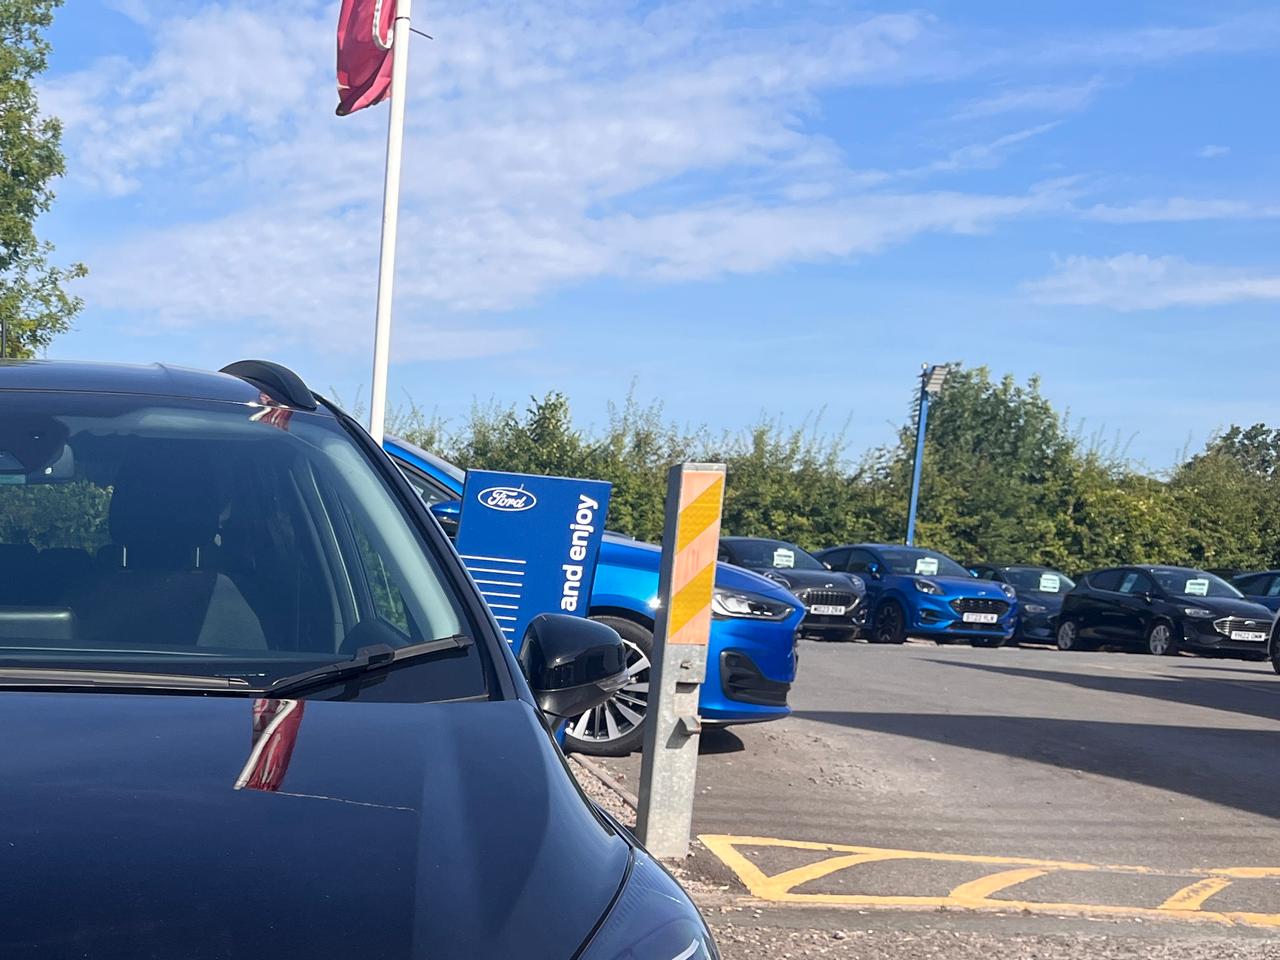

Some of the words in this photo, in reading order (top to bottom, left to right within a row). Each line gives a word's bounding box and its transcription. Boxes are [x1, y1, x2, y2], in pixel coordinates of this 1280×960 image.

[487, 490, 527, 507] Ford
[569, 494, 598, 561] enjoy
[561, 564, 583, 612] and
